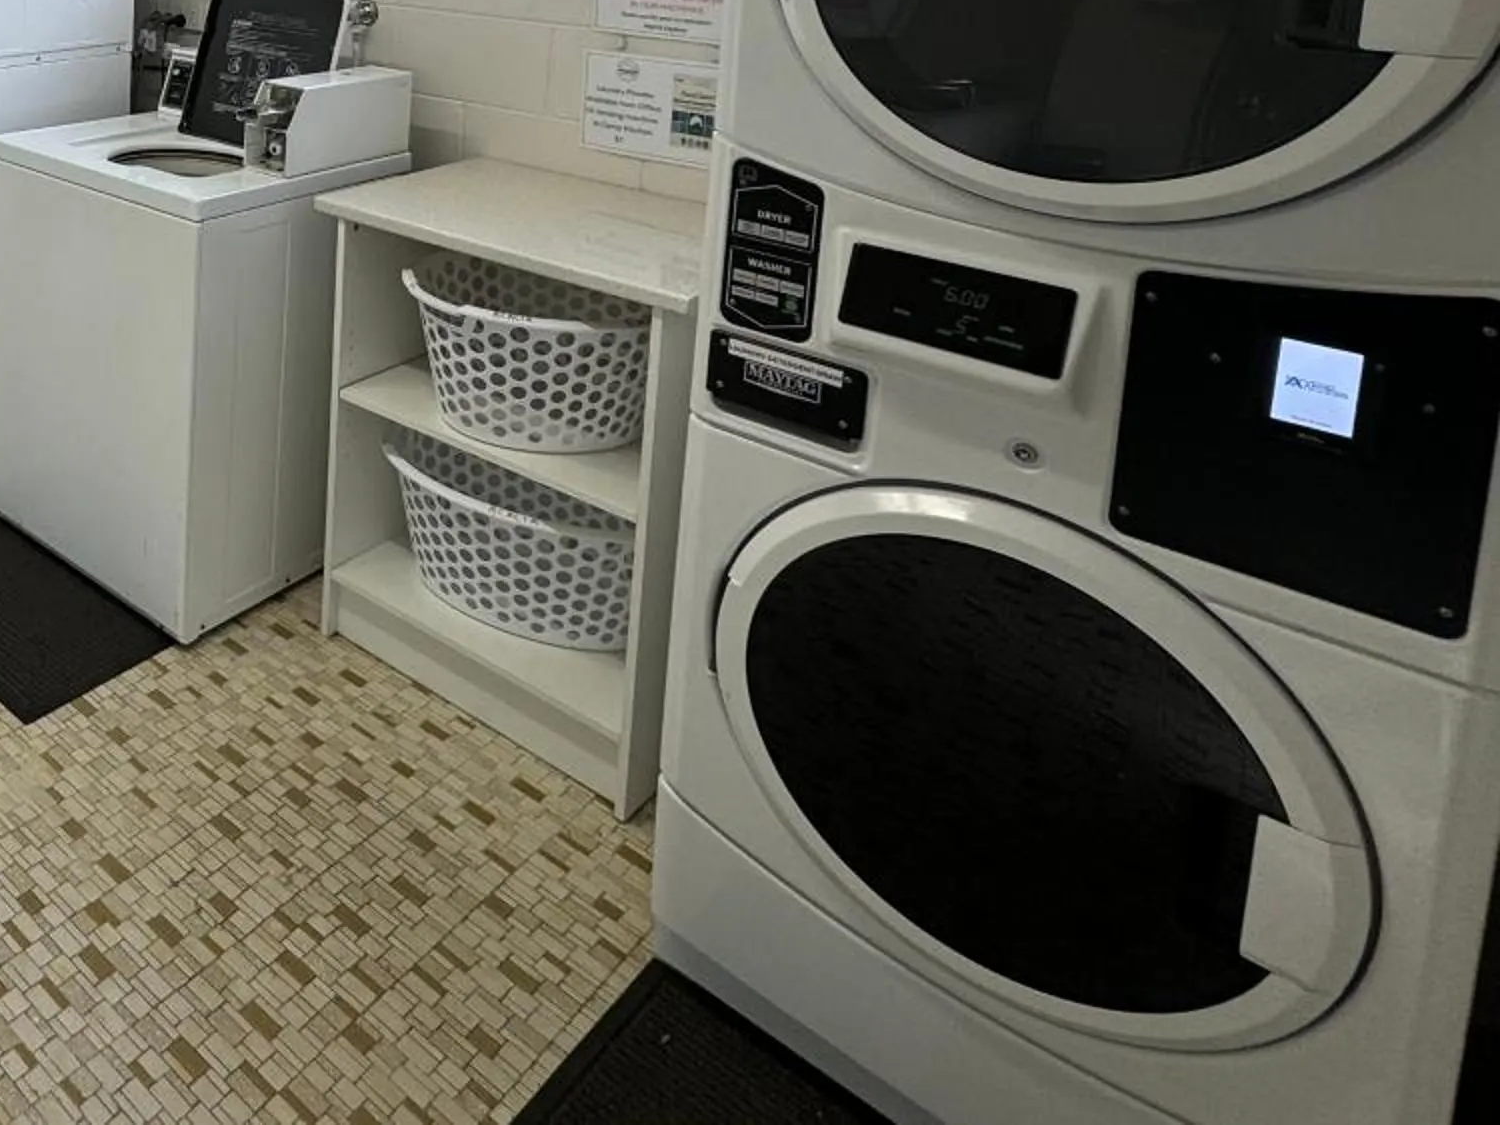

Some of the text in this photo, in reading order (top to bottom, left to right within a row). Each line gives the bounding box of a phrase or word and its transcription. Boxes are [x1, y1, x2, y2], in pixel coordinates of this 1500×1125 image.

[757, 209, 792, 225] DRYER
[747, 257, 792, 276] WASHER
[747, 361, 817, 395] MAYTAG
